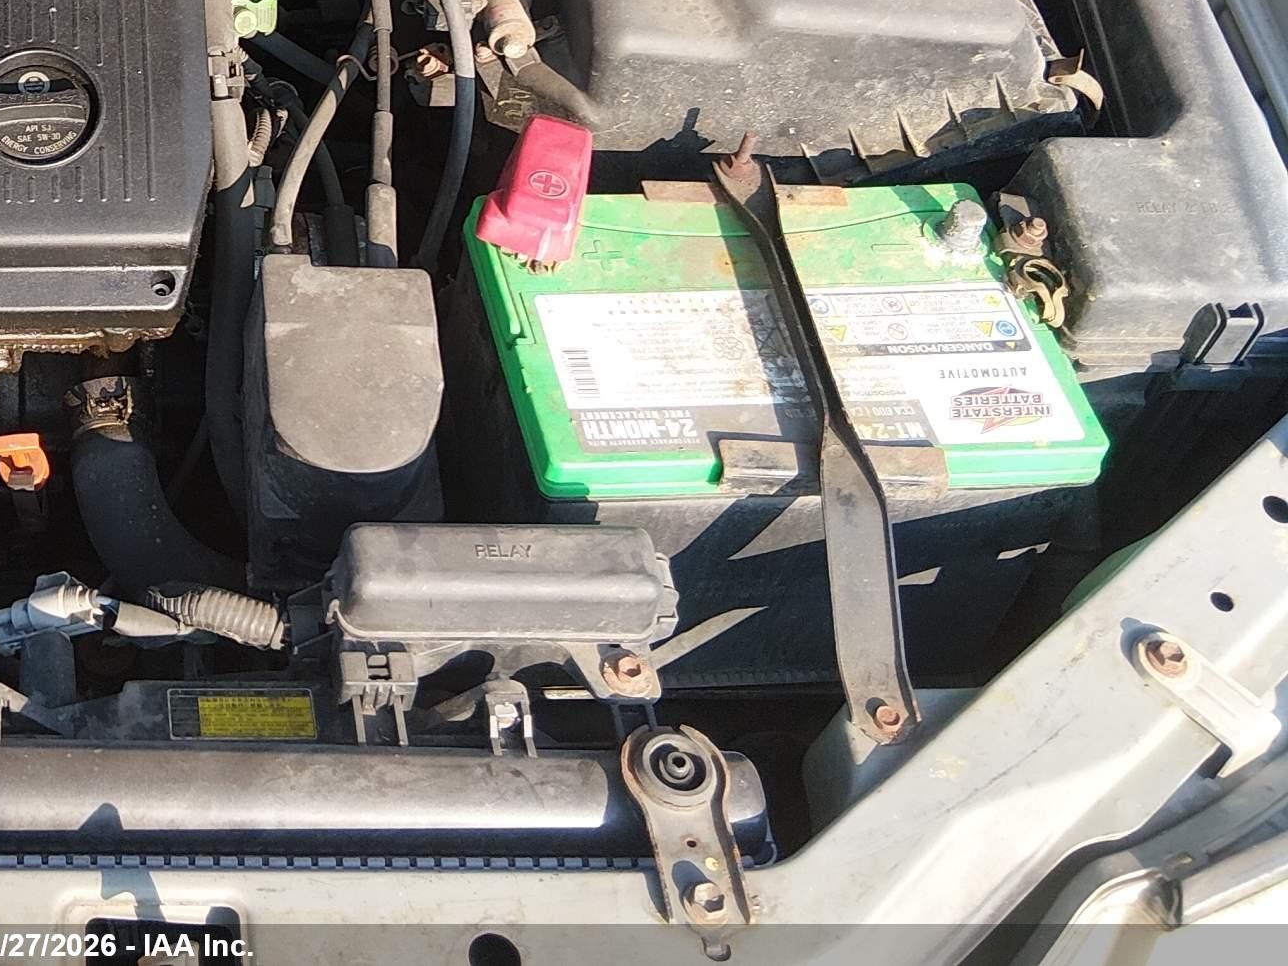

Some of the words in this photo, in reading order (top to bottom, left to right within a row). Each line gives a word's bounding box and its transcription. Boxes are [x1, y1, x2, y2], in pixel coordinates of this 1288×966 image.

[25, 124, 38, 132] API
[0, 135, 29, 153] ENERGY
[34, 130, 77, 154] CONSERVING
[17, 134, 32, 143] SAE
[37, 132, 61, 141] 5W-30
[887, 340, 994, 354] DANGER/POISON
[938, 367, 1027, 379] AUTOMOTIVE
[953, 394, 1042, 406] BATTERIES
[580, 411, 660, 420] REPLACEMENT
[951, 405, 1051, 417] INTERSTATE
[581, 418, 698, 440] 24-MONTH
[474, 544, 532, 558] RELAY
